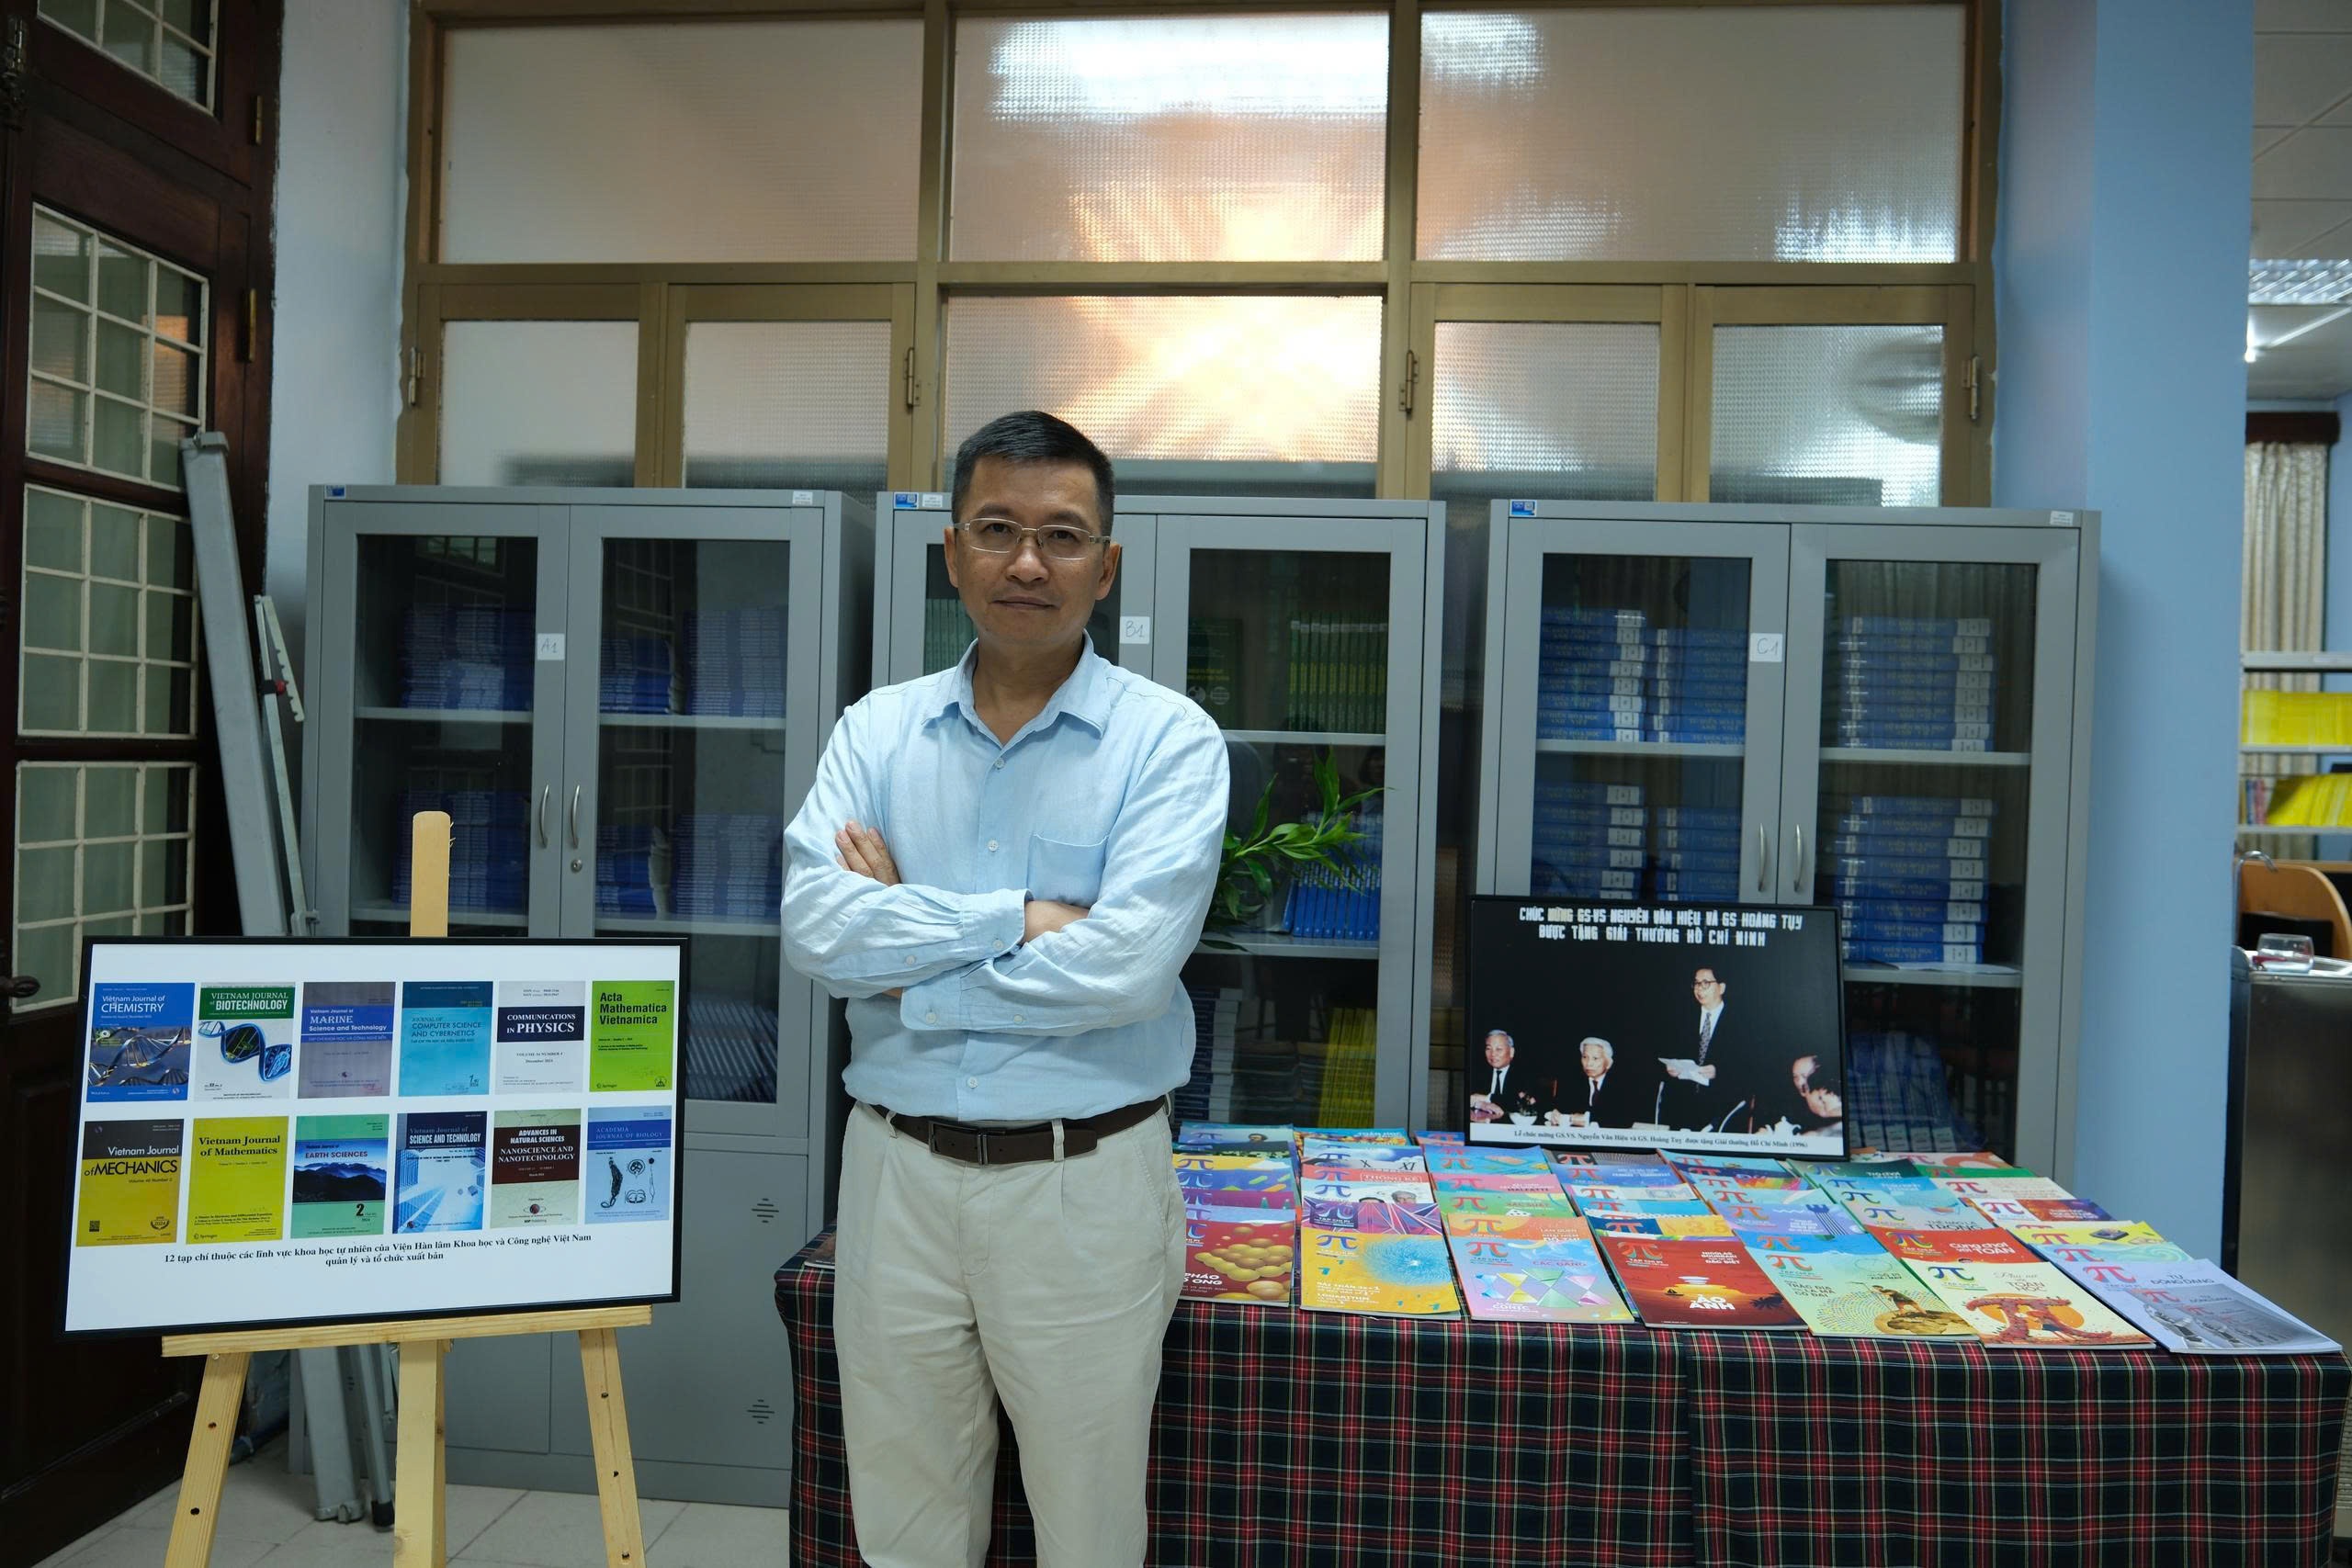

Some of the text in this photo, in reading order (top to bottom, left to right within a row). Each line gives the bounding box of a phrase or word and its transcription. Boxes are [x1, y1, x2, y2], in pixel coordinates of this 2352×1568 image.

[1722, 912, 1736, 928] GS
[252, 992, 288, 1000] JOURNAL
[600, 992, 623, 1002] Acta
[101, 1003, 164, 1013] CHEMISTRY
[215, 999, 288, 1010] BIOTECHNOLOGY
[600, 1003, 667, 1013] Mathematica
[600, 1014, 658, 1025] Vietnamica
[516, 1022, 575, 1033] PHYSICS
[518, 1129, 549, 1137] ADVANCES
[198, 1135, 280, 1146] Vietnam Journal
[409, 1133, 481, 1145] SCIENCE AND TECHNOLOGY
[510, 1136, 537, 1145] NATURAL
[107, 1145, 179, 1156] Vietnam Journal
[200, 1146, 277, 1156] of Mathematics
[501, 1145, 556, 1155] NANOSCIENCE
[498, 1153, 576, 1163] NANOTECHNOLOGY
[85, 1159, 178, 1177] of MECHANICS
[356, 1203, 365, 1217] 2
[164, 1233, 592, 1264] 12 tạp chí thuộc các lĩnh vực khoa học tự nhiên của Viện Hàn lâm Khoa học và Công nghệ Việt Nam
[325, 1250, 444, 1267] quản lý và tổ chức xuất bản
